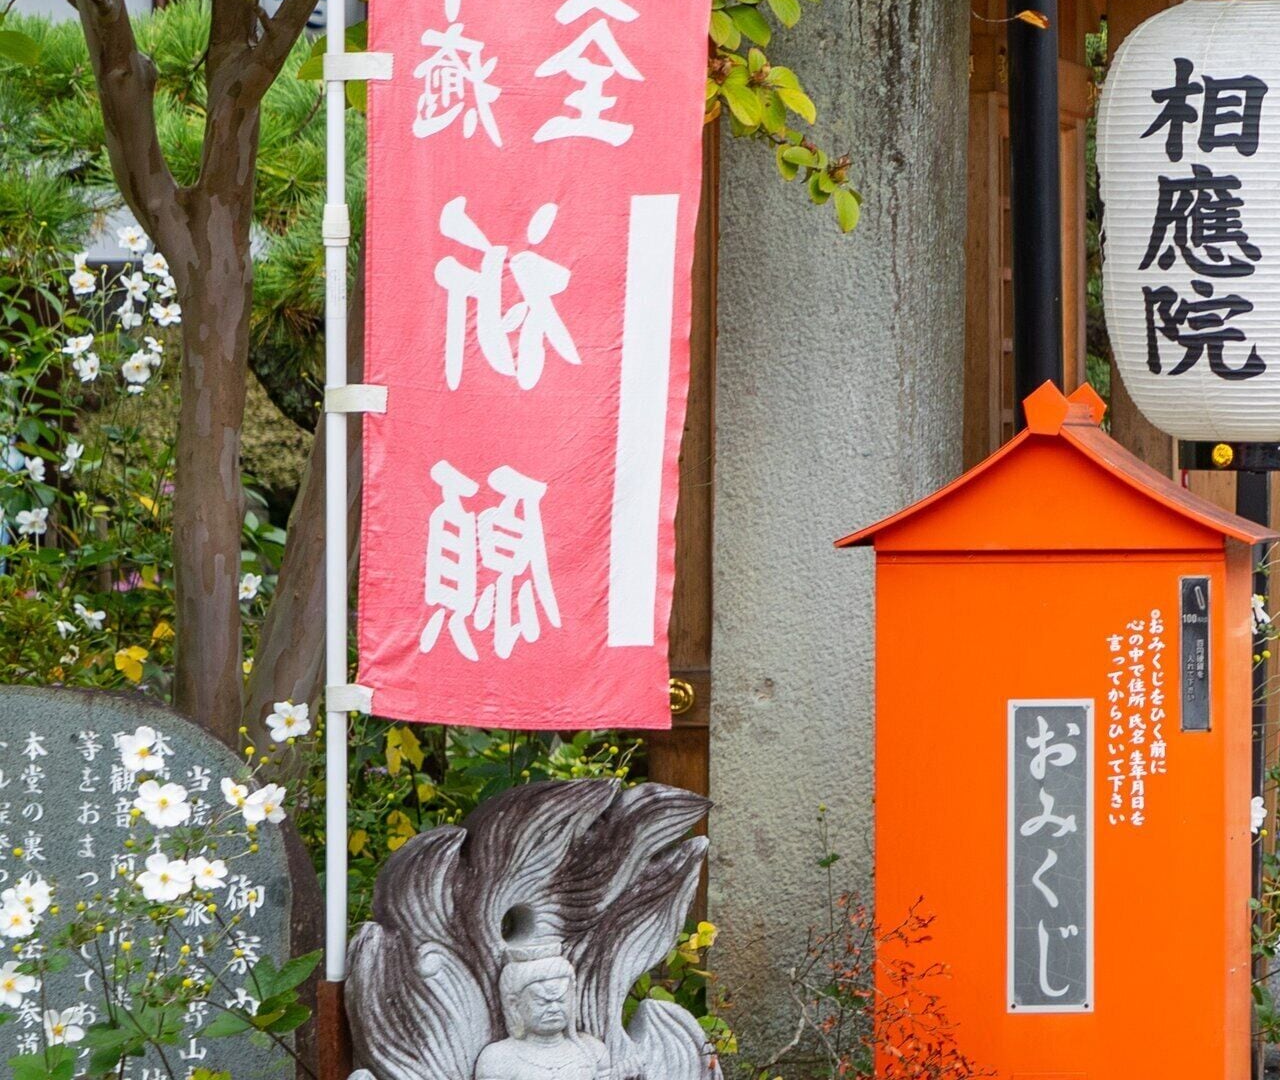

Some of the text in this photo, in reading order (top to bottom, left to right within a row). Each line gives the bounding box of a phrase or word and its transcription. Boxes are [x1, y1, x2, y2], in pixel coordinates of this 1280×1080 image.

[1138, 57, 1269, 381] 相應院
[1020, 715, 1080, 998] おみくじ
[1106, 634, 1125, 825] 言ってからひいて下さい
